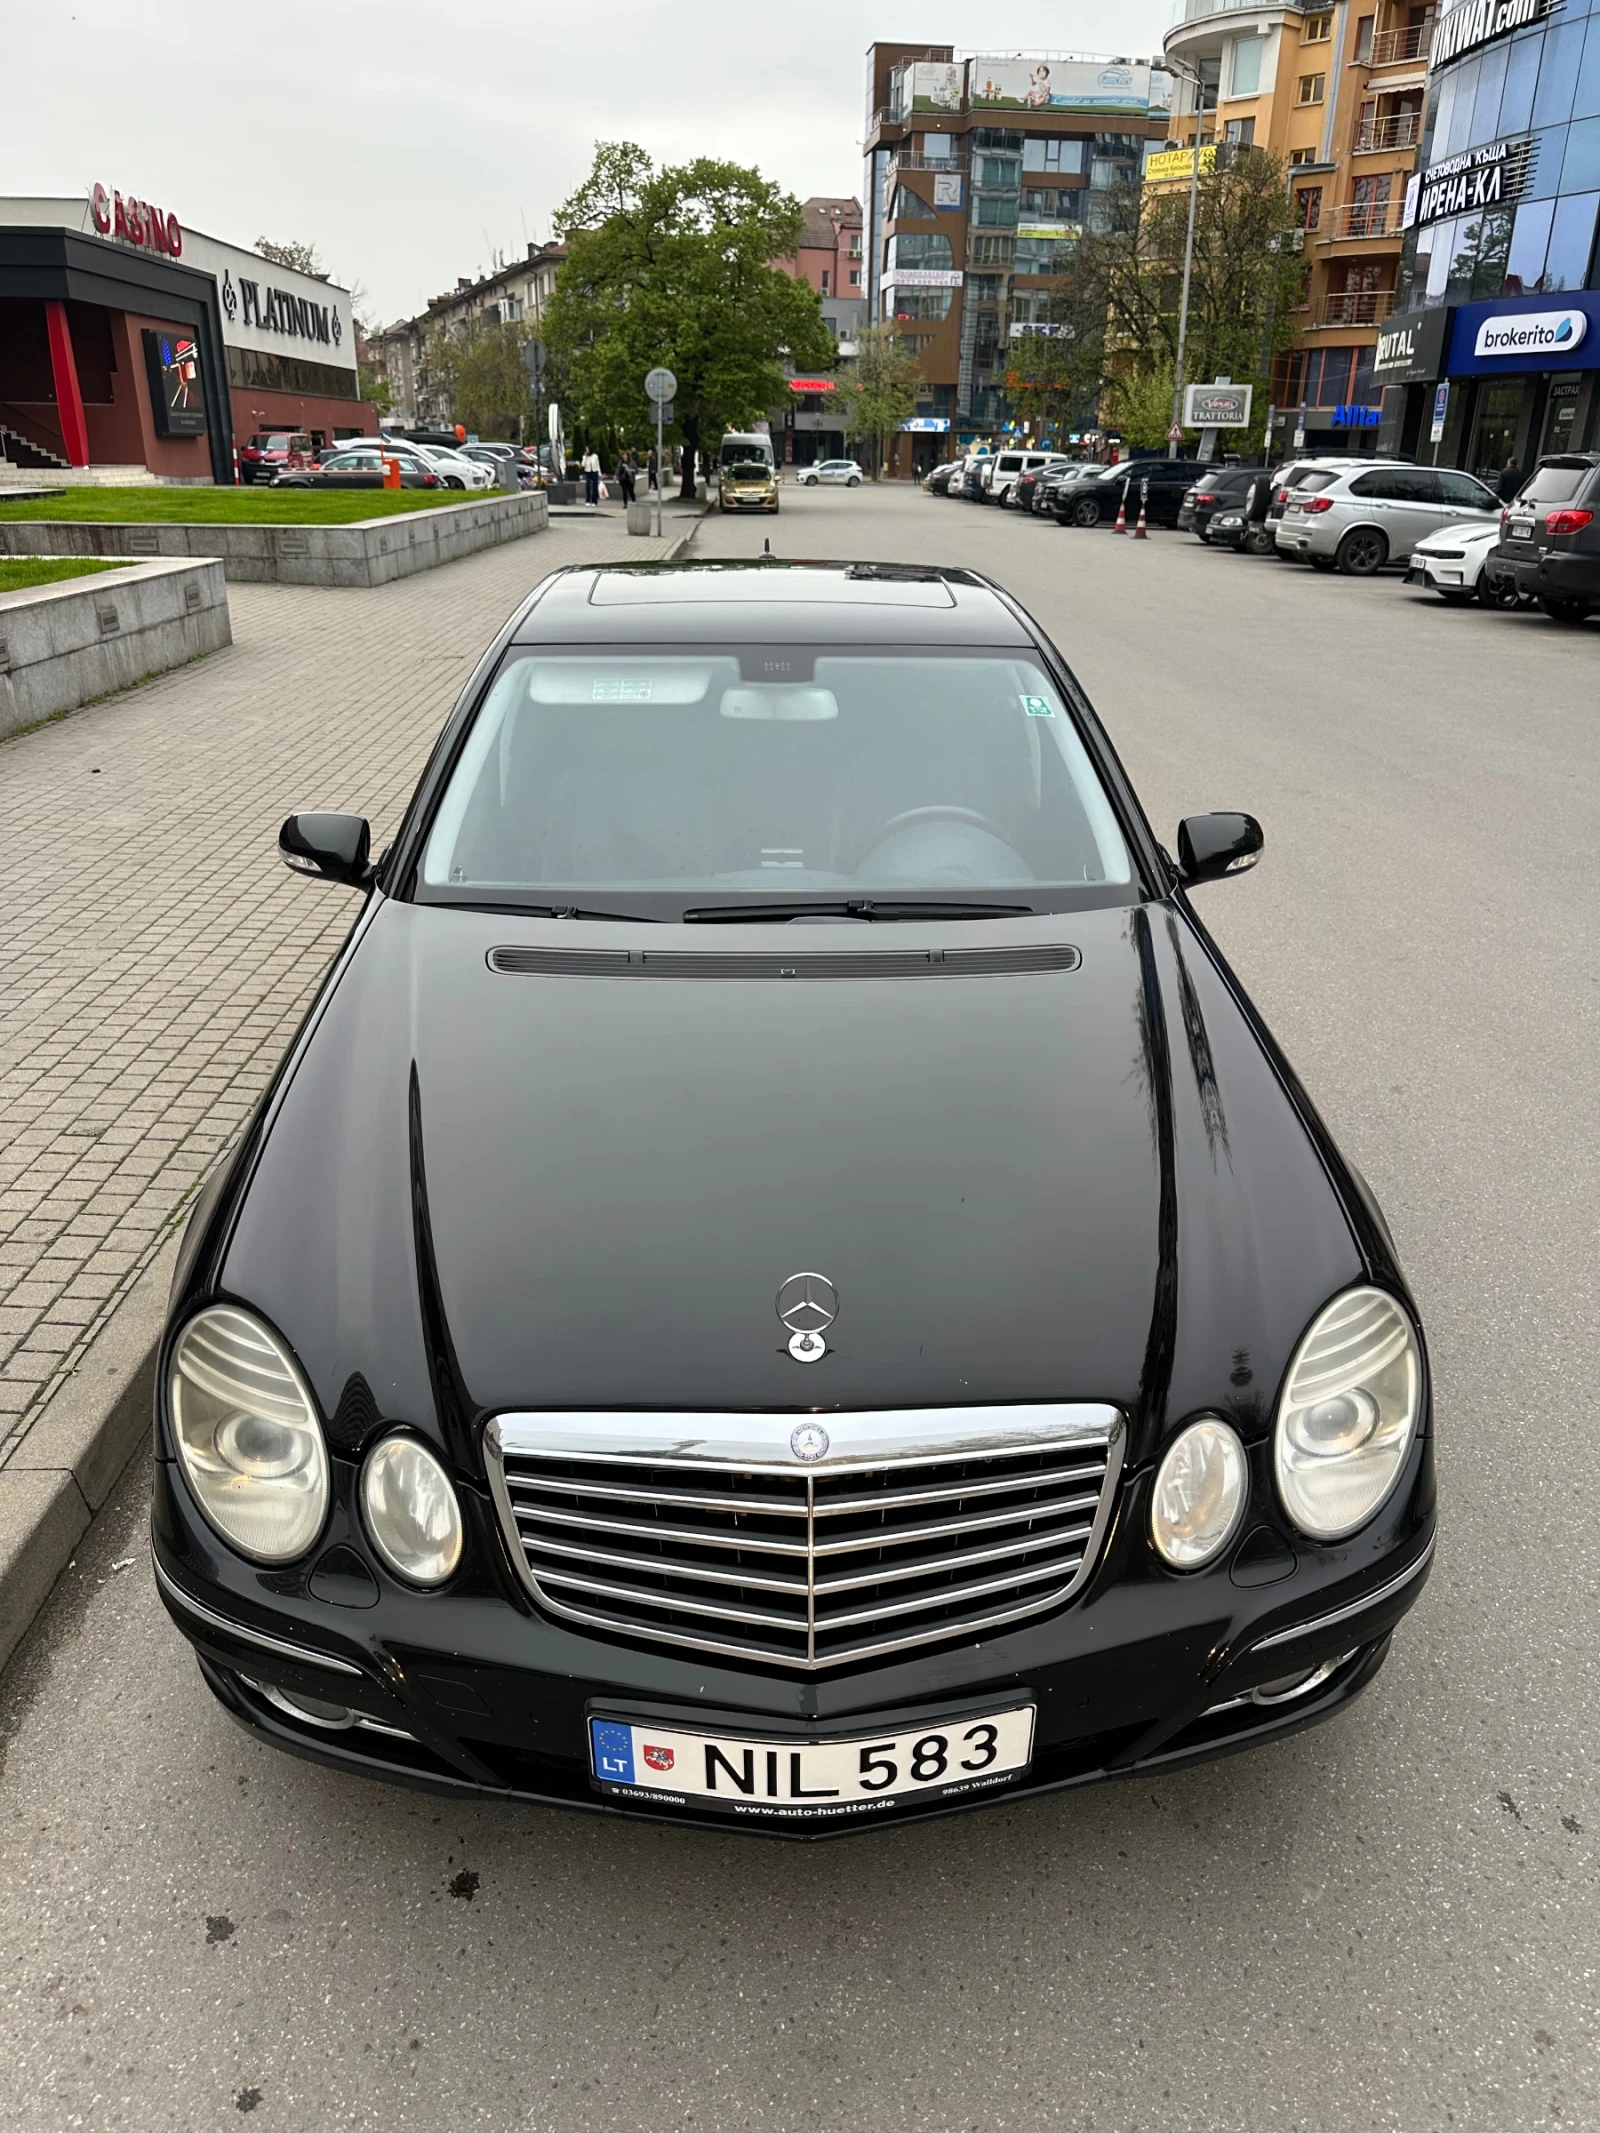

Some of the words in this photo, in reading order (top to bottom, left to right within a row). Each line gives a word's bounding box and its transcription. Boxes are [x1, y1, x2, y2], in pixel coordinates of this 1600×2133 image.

[1425, 153, 1472, 184] СЧЕТОВОДНА
[1475, 143, 1507, 164] КЪЩА
[1419, 166, 1501, 222] ИРЕНА-КЛ
[91, 182, 183, 257] CASINO
[239, 277, 331, 345] PLATINUM
[1484, 324, 1555, 348] brokerito
[1193, 411, 1243, 421] TRATTORIA
[602, 1756, 627, 1773] LT
[704, 1743, 840, 1798] NIL
[859, 1723, 998, 1791] 583
[622, 1787, 686, 1805] 03693/890000
[942, 1784, 970, 1796] 98639
[972, 1774, 1014, 1789] Walldorf
[734, 1800, 896, 1817] www.auto-huetter.de
